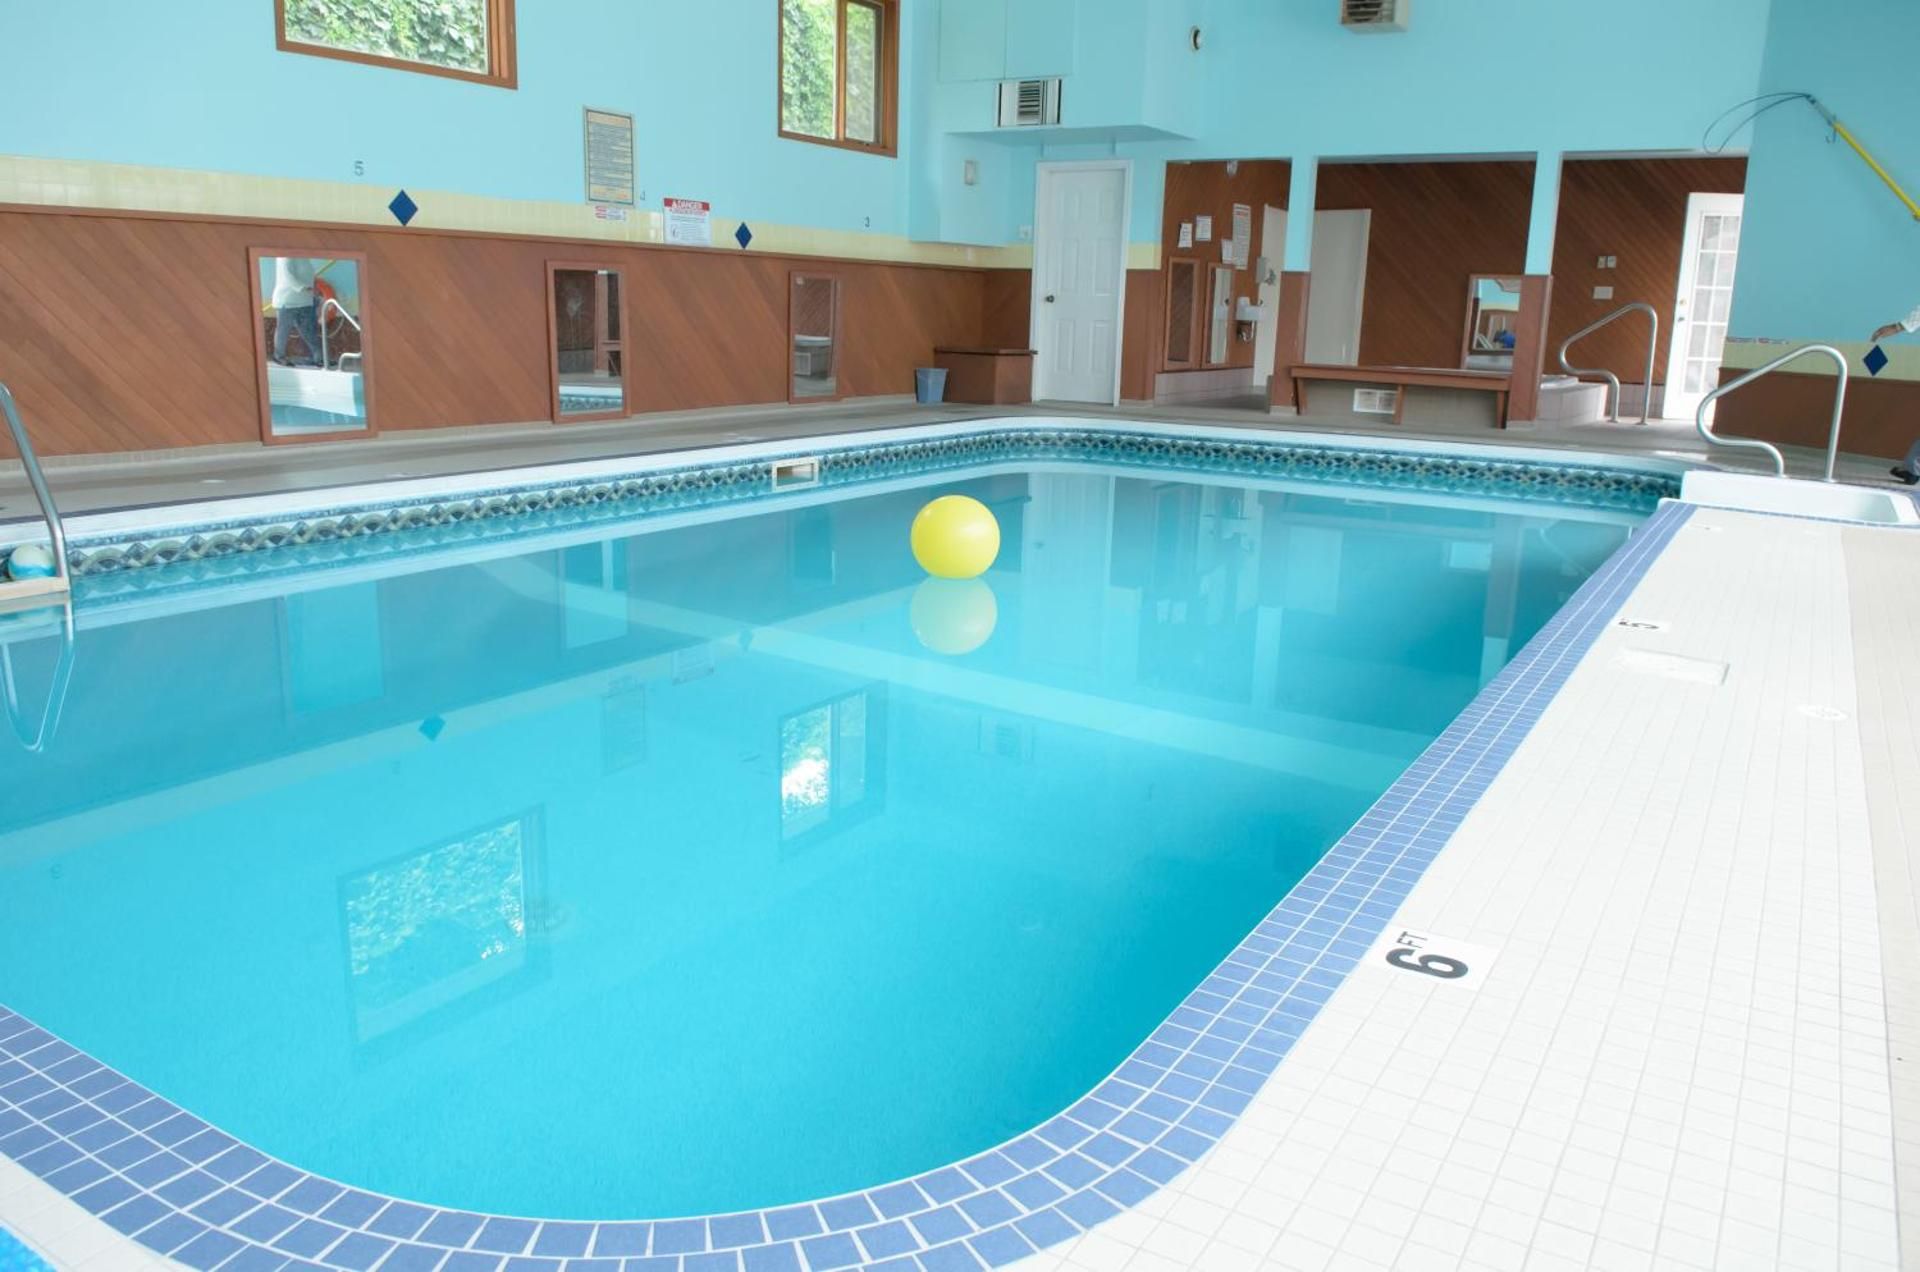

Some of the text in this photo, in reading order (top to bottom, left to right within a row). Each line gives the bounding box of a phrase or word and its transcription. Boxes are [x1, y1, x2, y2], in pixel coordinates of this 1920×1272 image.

[354, 160, 364, 176] 5
[1385, 931, 1469, 979] 6 FT
